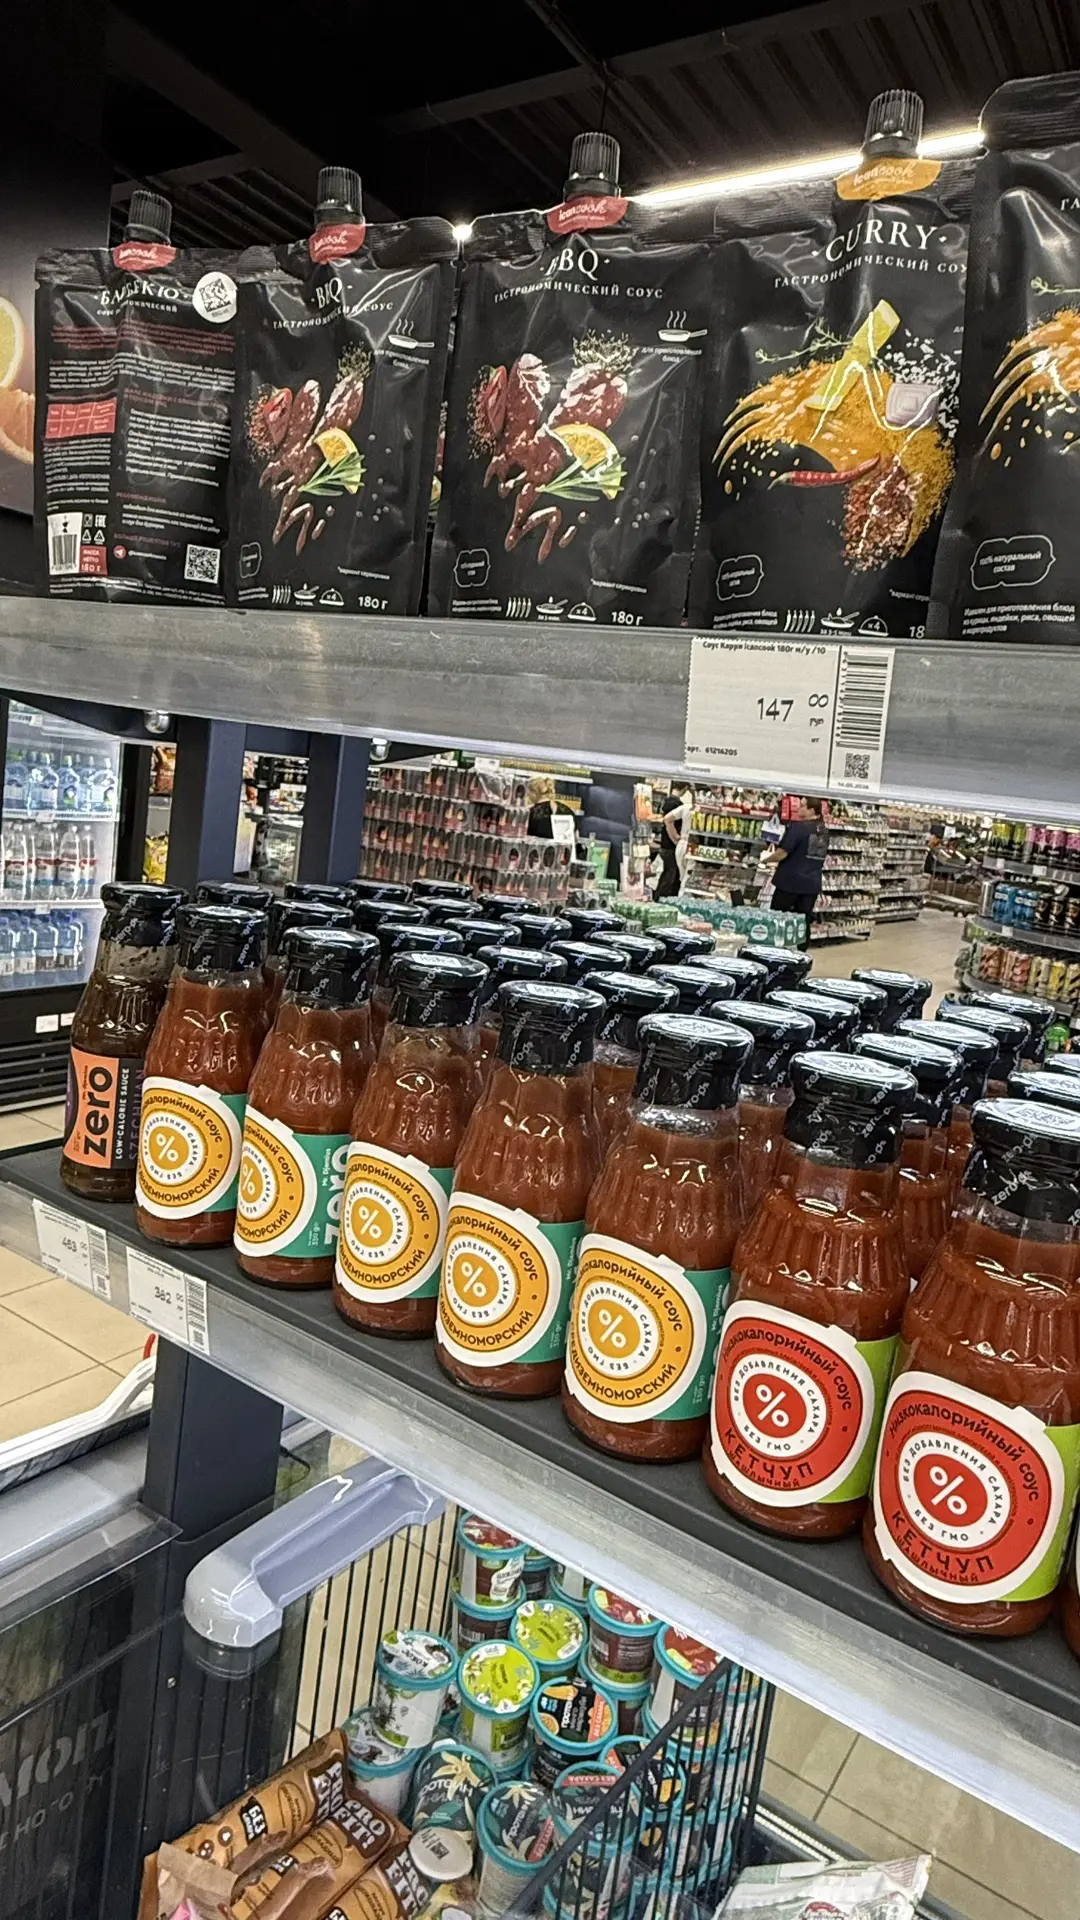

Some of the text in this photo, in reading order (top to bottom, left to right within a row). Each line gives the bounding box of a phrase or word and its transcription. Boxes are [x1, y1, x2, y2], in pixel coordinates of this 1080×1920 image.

[825, 219, 938, 262] CURRY
[774, 254, 968, 288] ГАСТРОНОМИЧЕСКИЙ СОУ
[494, 280, 663, 303] ГАСТРОНОМИЧЕСКИЙ СОУС
[358, 596, 379, 609] 180
[611, 610, 644, 625] 180 г
[1041, 613, 1076, 622] овощей
[1052, 602, 1076, 613] блюд
[702, 641, 720, 650] Соус
[720, 642, 743, 651] Карри
[908, 625, 926, 639] 18
[756, 696, 795, 722] 147
[704, 748, 738, 757] 61216205
[83, 1066, 113, 1158] zero
[115, 1068, 130, 1160] LOW-CALORIE SAUCE
[206, 1119, 223, 1143] соус
[277, 1156, 294, 1183] соус
[411, 1194, 430, 1222] соус
[519, 1251, 539, 1281] соус
[663, 1300, 683, 1331] соус
[640, 1314, 652, 1357] САХАРА
[738, 1360, 805, 1387] ДОБАВЛЕНИЯ
[806, 1389, 820, 1434] САХАРА
[833, 1375, 852, 1410] соус
[725, 1427, 814, 1480] КЕТЧУП
[909, 1439, 987, 1472] ДОБАВЛЕНИЯ
[988, 1475, 1003, 1525] САХАРА
[1019, 1462, 1039, 1501] соус
[891, 1510, 995, 1574] КЕТЧУП
[896, 1535, 979, 1582] ШАШЛЫЧНЫЙ
[332, 1806, 377, 1850] FIT!
[344, 1800, 387, 1837] PRO
